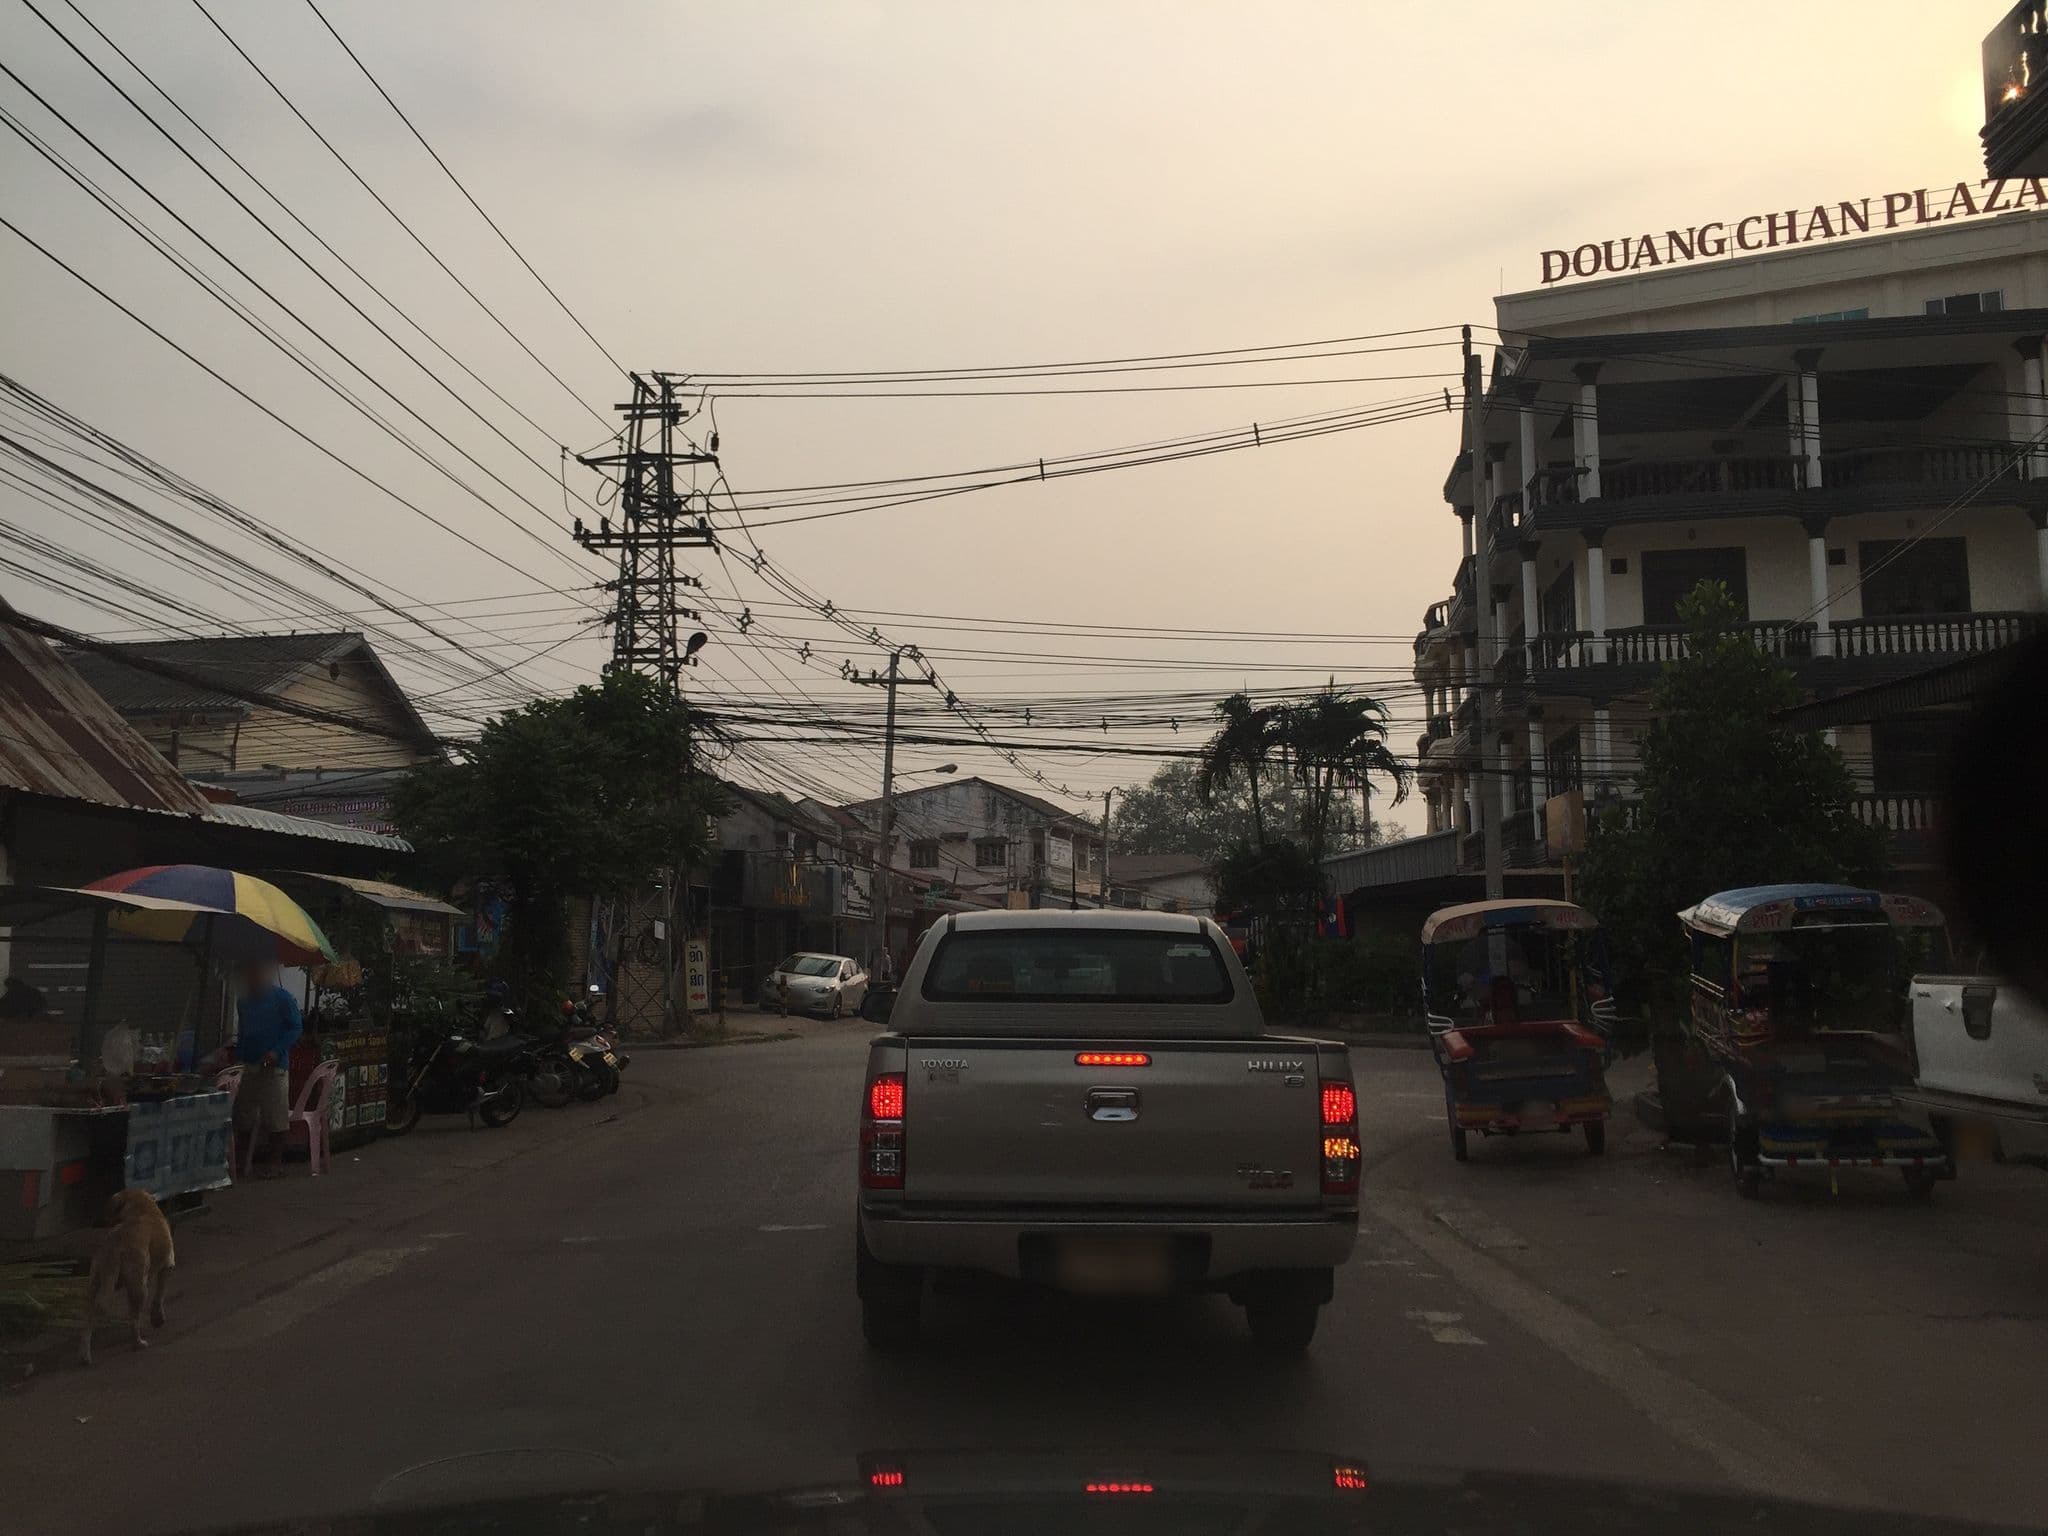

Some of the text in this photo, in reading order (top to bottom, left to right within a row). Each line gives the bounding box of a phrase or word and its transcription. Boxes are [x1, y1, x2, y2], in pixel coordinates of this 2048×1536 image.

[1541, 176, 2048, 284] DOUANG CHAN PLAZA
[920, 1058, 969, 1069] TOYOTA
[1248, 1060, 1304, 1072] HILUX
